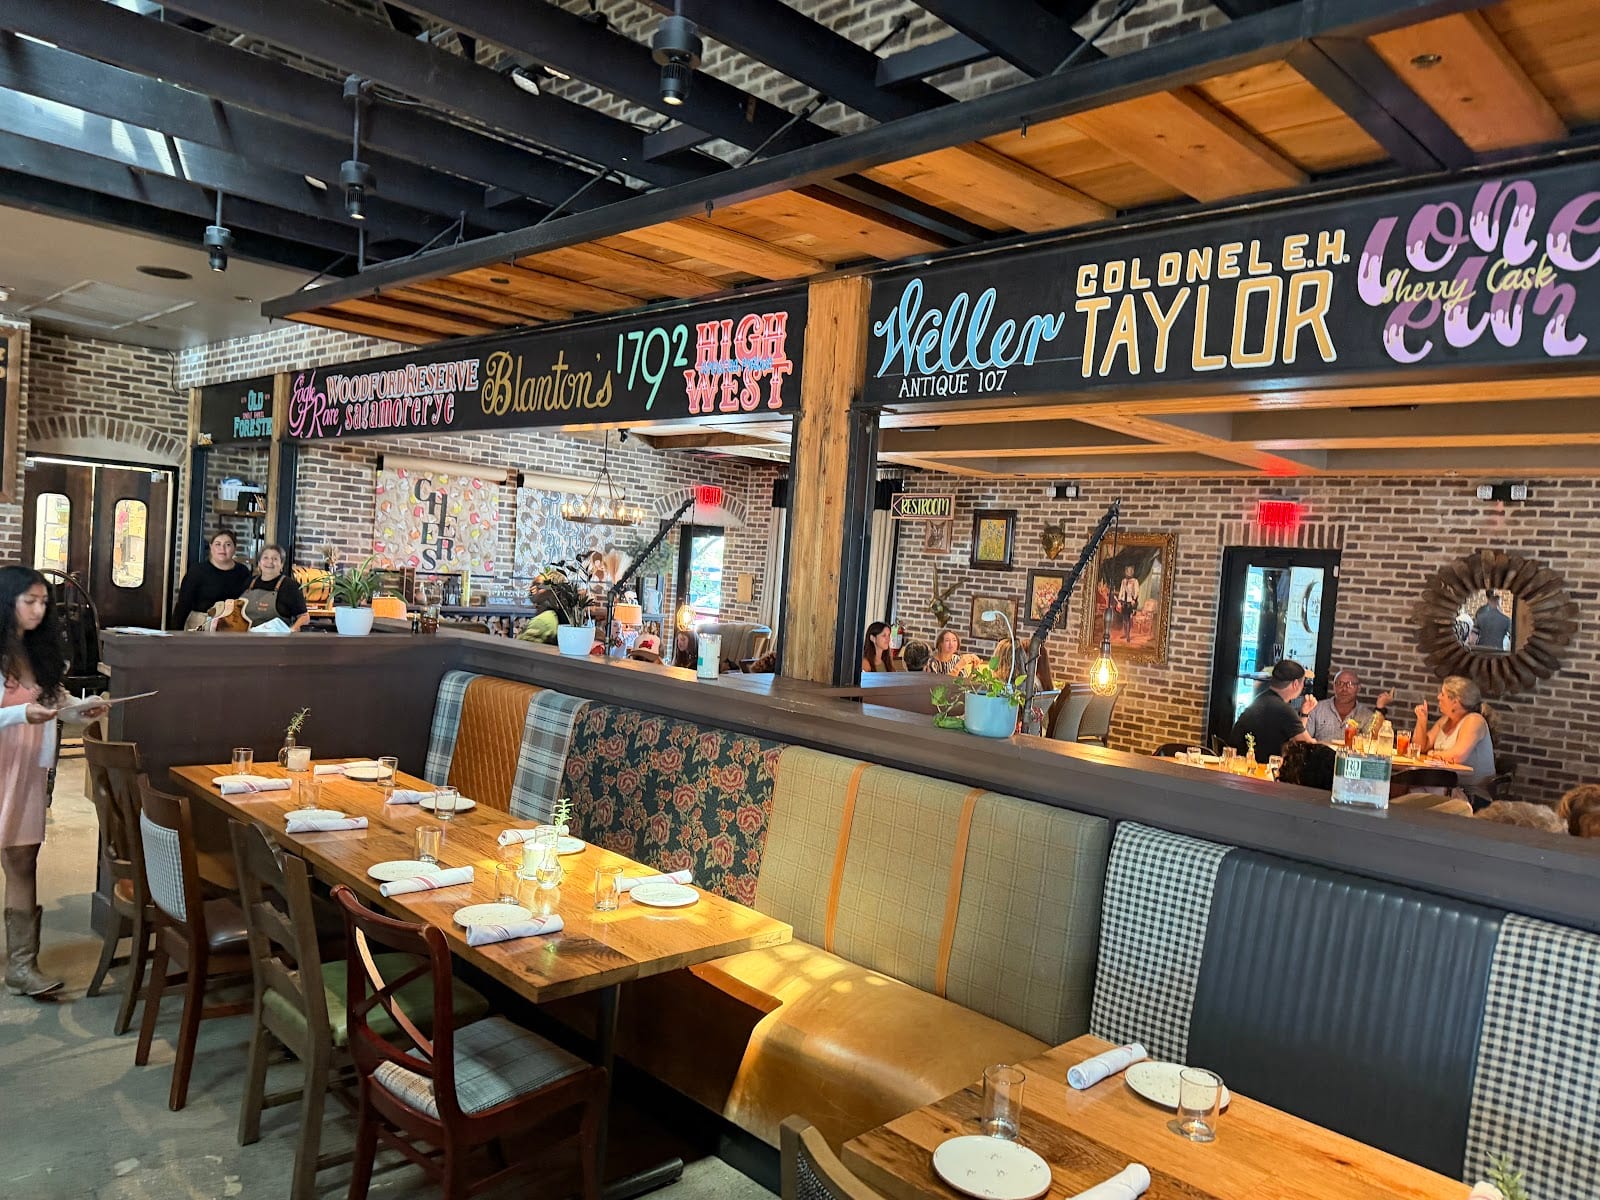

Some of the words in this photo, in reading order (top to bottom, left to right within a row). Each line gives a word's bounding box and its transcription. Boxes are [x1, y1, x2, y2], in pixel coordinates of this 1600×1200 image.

[1076, 240, 1272, 297] COLONEL
[1282, 229, 1351, 271] E.H.
[1381, 267, 1476, 311] Sherry
[1487, 254, 1557, 293] Cask
[695, 311, 788, 371] HIGH
[873, 278, 1065, 378] Weller
[1075, 270, 1338, 378] TAYLOR
[481, 350, 613, 416] Blanton's
[617, 324, 688, 411] 1792
[683, 360, 793, 414] WEST
[899, 373, 969, 398] ANTIQUE
[979, 370, 1008, 391] 107
[233, 416, 272, 438] FORESTE
[247, 389, 264, 411] OLD
[901, 498, 949, 515] RESTROOM
